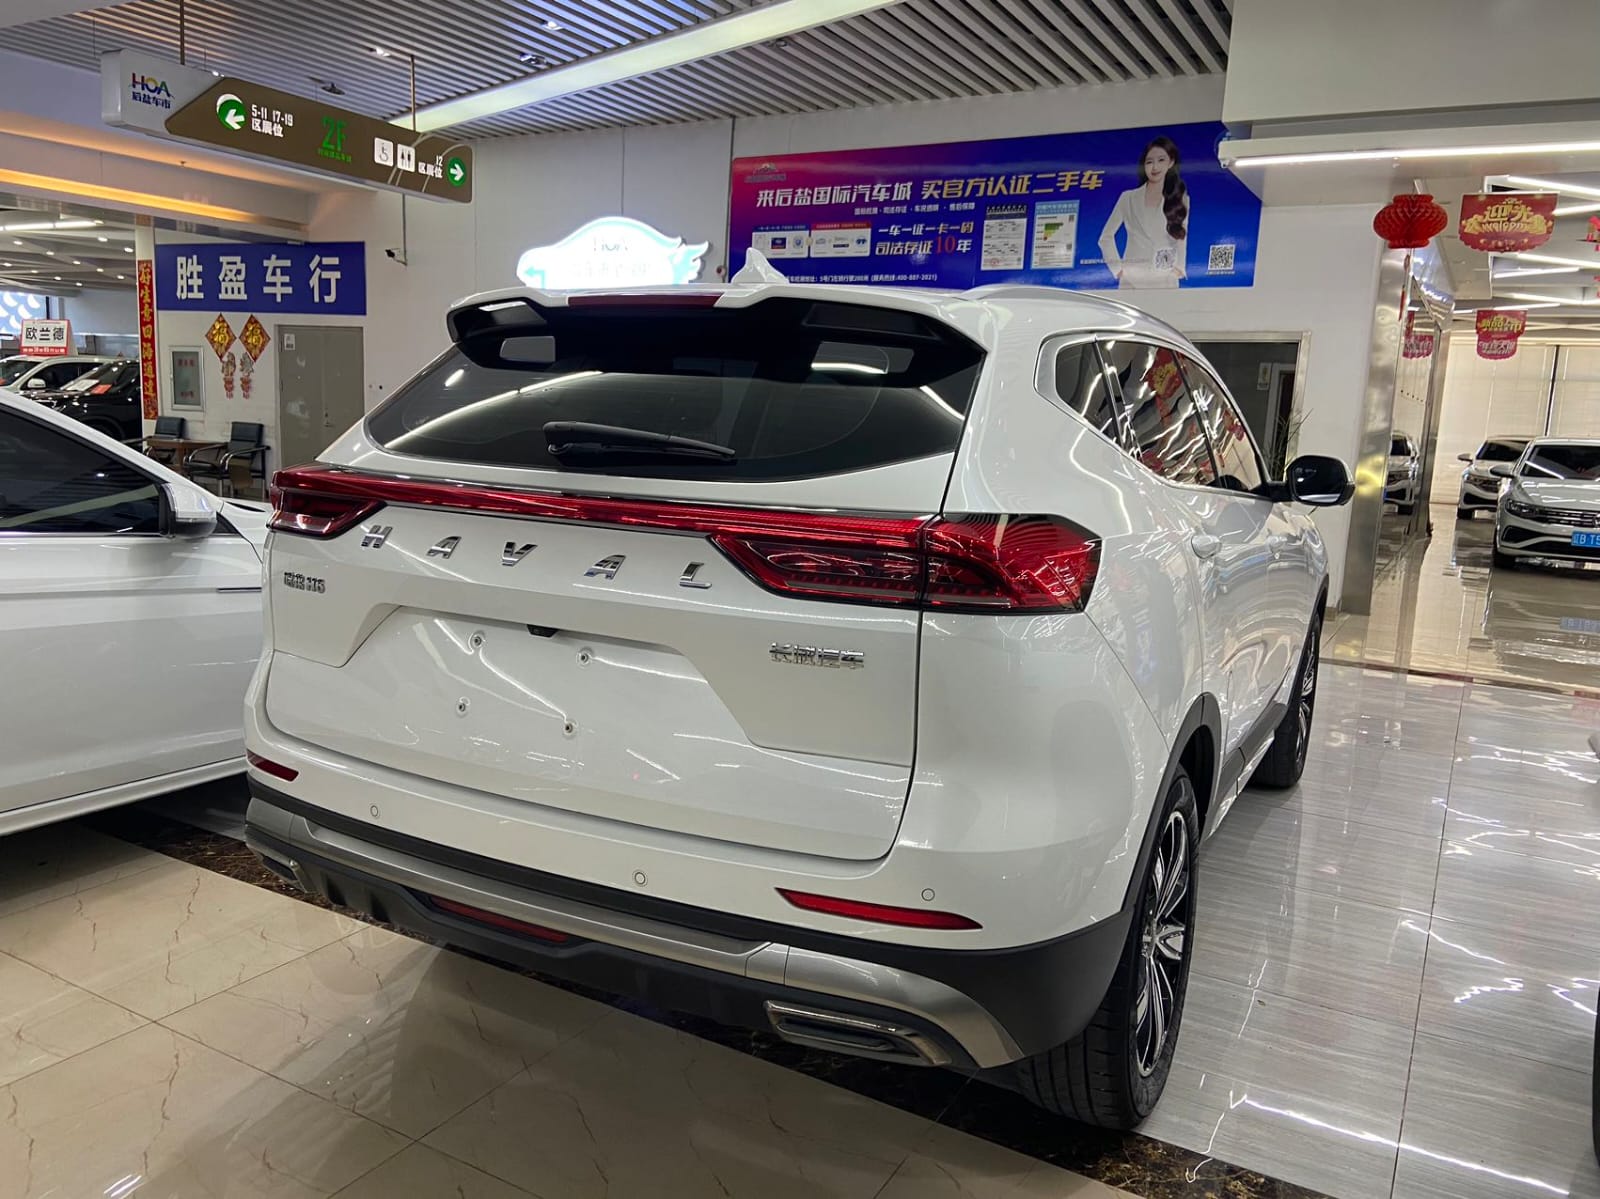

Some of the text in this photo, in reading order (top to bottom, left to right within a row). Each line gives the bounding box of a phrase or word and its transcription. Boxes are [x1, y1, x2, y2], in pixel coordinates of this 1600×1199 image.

[132, 73, 174, 97] HOA
[252, 104, 294, 127] 5-11 17-19
[251, 118, 284, 138] 区展位
[322, 116, 347, 151] 2F
[756, 169, 1105, 208] 来后盐国际汽车城 买官方认证二手车
[878, 221, 974, 236] 一车一证一卡一码
[875, 236, 972, 255] 司法存证10年
[176, 254, 340, 304] 胜盈车行
[25, 326, 64, 341] 欧兰德
[361, 523, 713, 590] HAVAL
